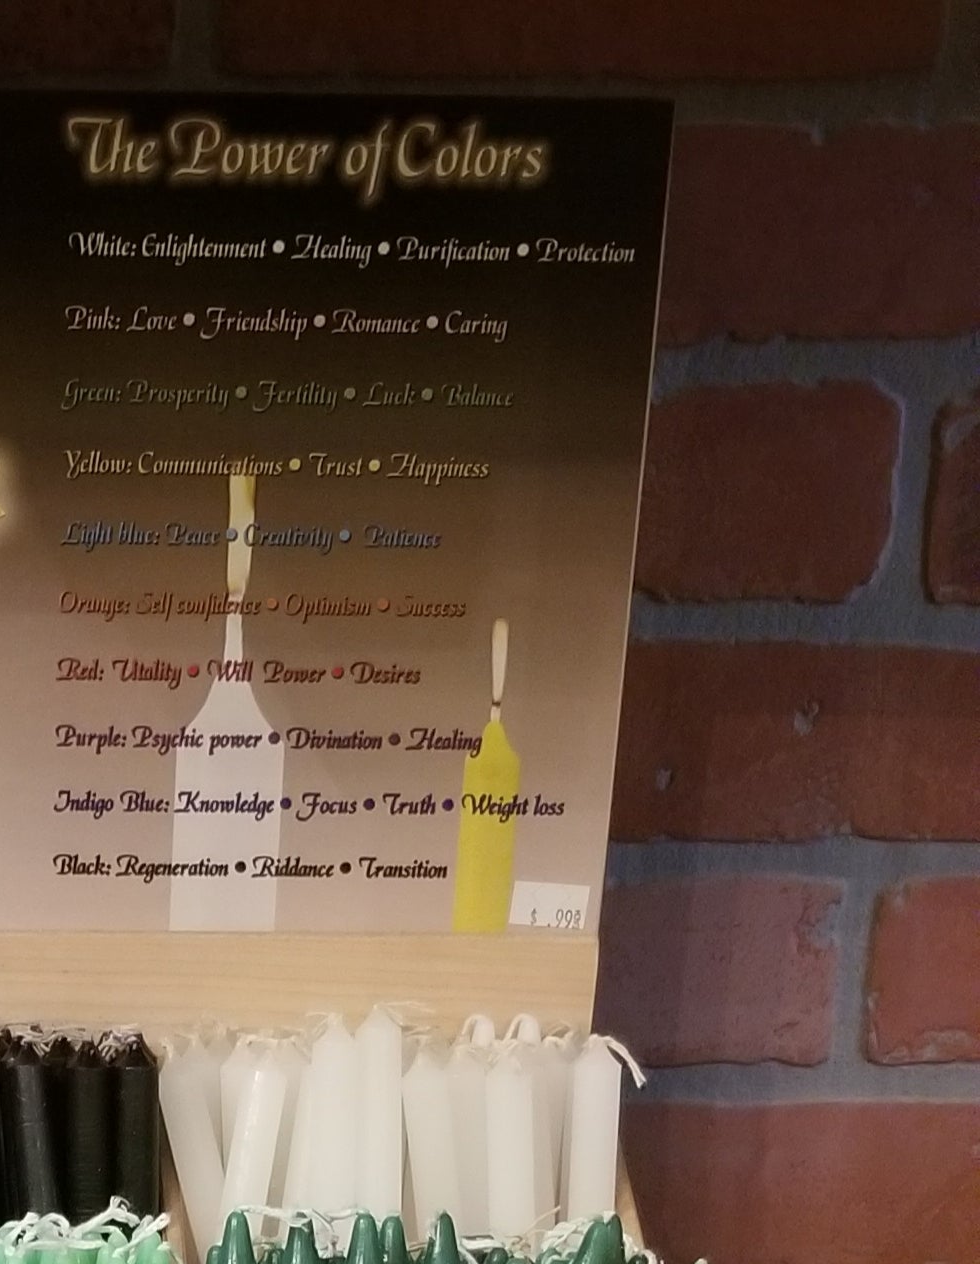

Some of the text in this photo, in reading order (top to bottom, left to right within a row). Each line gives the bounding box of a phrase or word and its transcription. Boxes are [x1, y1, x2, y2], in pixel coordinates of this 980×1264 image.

[68, 117, 542, 198] The Power of Colors
[69, 232, 636, 269] White: Enlightenment Healing Purification Protection
[65, 305, 508, 343] Pink: Love Friendship Romance Caring
[61, 378, 514, 414] Green: Prosperity Fertility Luck Balance
[65, 449, 490, 485] Yellow: Communications Trust Happiness
[60, 521, 442, 556] Light blue: Peace Creativity Patience
[59, 591, 467, 625] Orange: Self confidence Optimism Success
[55, 657, 105, 682] Red:
[207, 659, 253, 683] Will
[263, 660, 326, 684] Power
[349, 661, 421, 685] Desires
[55, 724, 483, 758] Purple: Psychic power Divination Healing
[53, 790, 565, 823] Indigo Blue: Knowledge Focus Truth Weight loss
[53, 853, 448, 884] Black: Regeneration Riddance Transition
